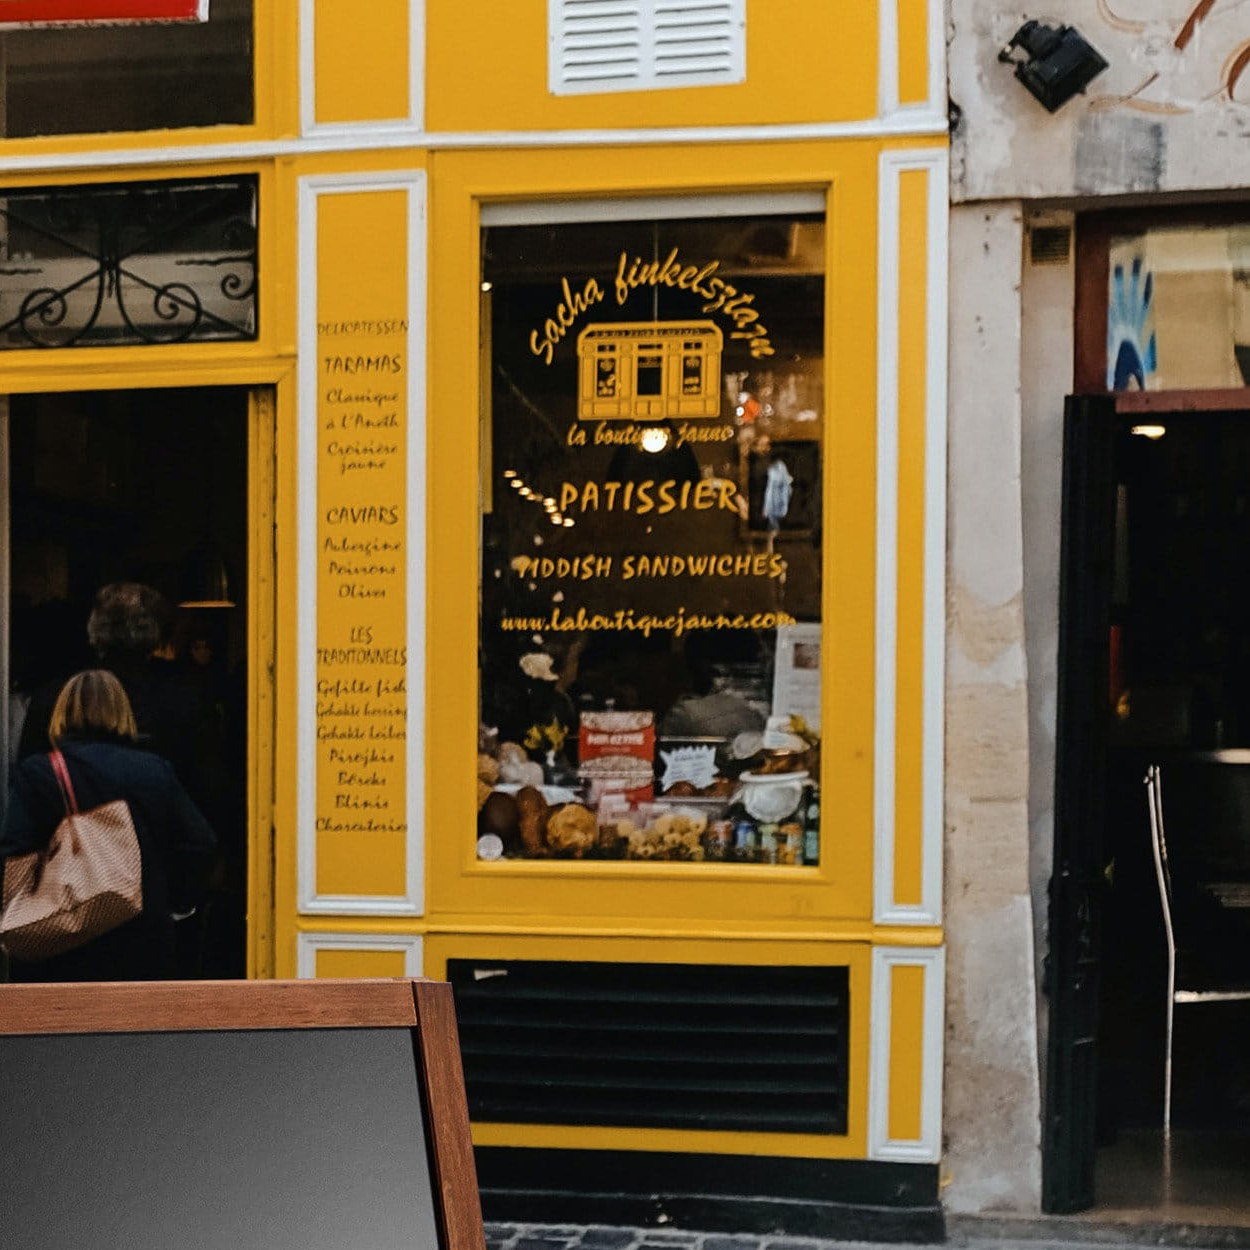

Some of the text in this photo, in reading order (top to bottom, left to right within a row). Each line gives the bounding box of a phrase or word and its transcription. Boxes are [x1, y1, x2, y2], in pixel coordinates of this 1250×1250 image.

[317, 320, 408, 335] DELICATESSEN
[530, 276, 604, 365] Sacha
[325, 354, 401, 374] TARAMAS
[566, 420, 732, 450] la bouti jaune
[560, 478, 740, 514] PATISSIER
[326, 505, 398, 525] CAVIARS
[622, 552, 784, 580] SANDWICHES
[350, 625, 374, 645] LES
[335, 794, 388, 809] Blinis
